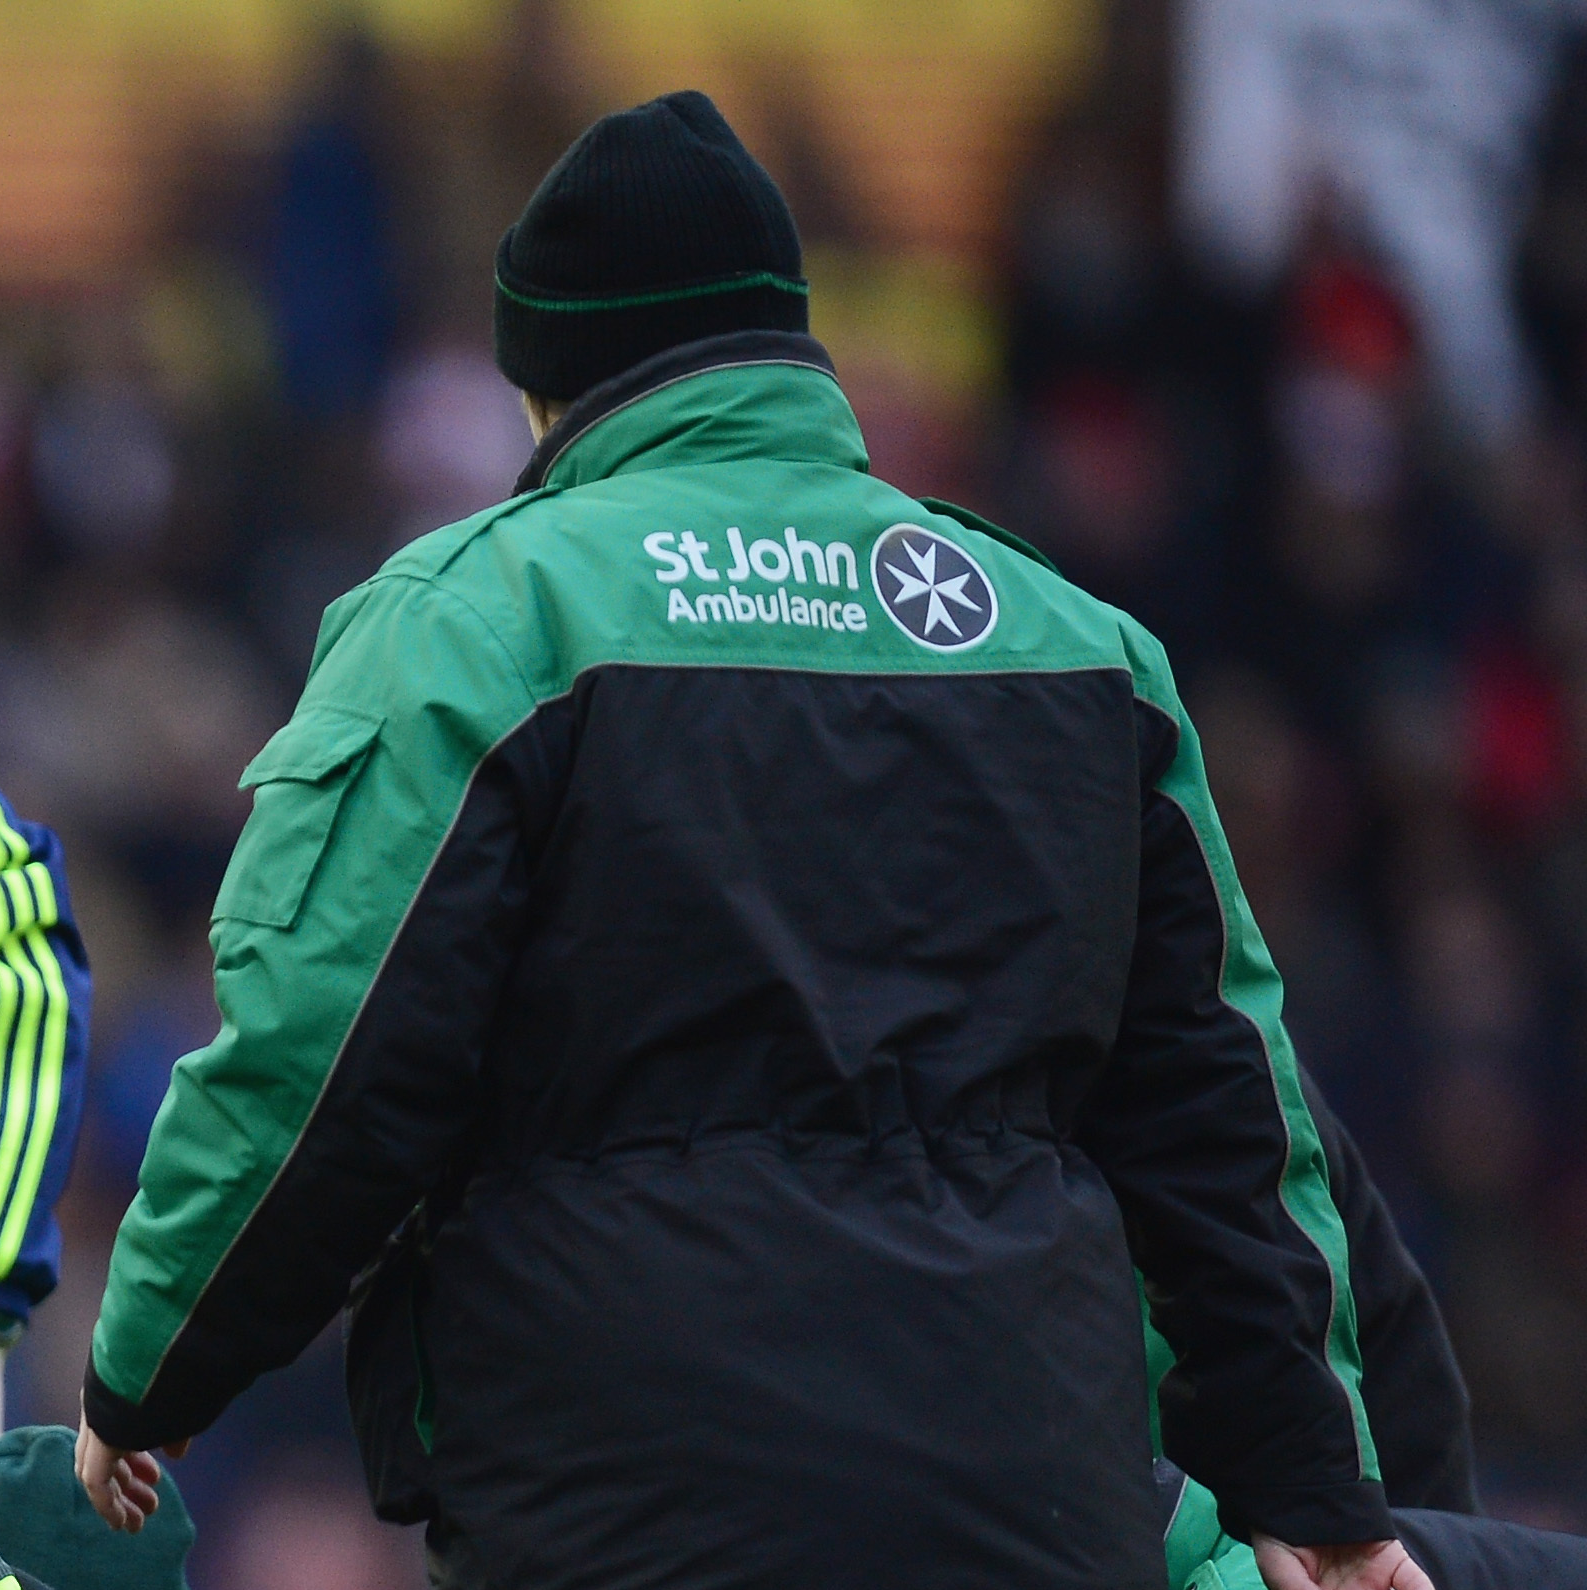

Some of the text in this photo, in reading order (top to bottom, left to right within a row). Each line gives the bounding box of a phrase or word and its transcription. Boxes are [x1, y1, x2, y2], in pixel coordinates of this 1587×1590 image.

[643, 526, 859, 590] St John
[667, 585, 868, 632] Ambulance
